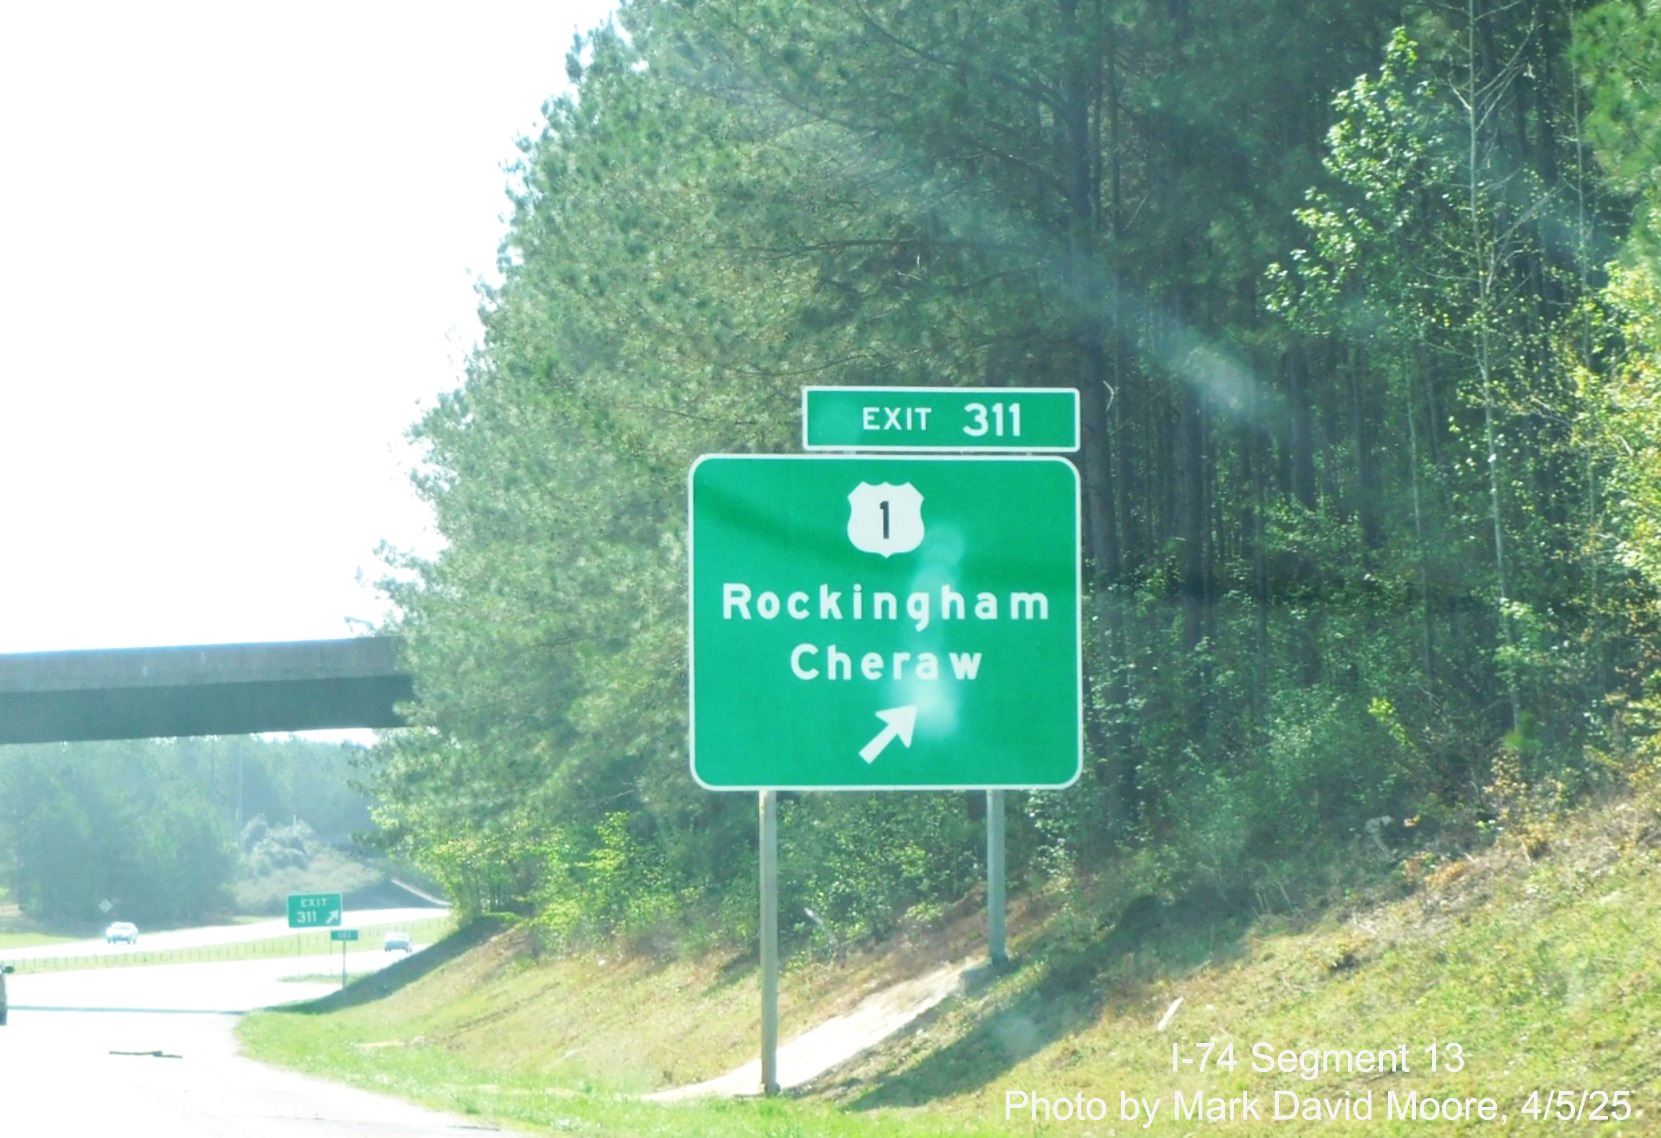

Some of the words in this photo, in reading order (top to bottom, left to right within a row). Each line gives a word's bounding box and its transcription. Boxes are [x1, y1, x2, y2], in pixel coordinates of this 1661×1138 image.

[862, 407, 932, 431] EXIT
[962, 403, 1021, 437] 311
[879, 500, 889, 539] 1
[723, 583, 1049, 632] Rockingham
[790, 643, 982, 680] Cheraw
[297, 911, 317, 923] 311
[301, 898, 327, 907] EXIT
